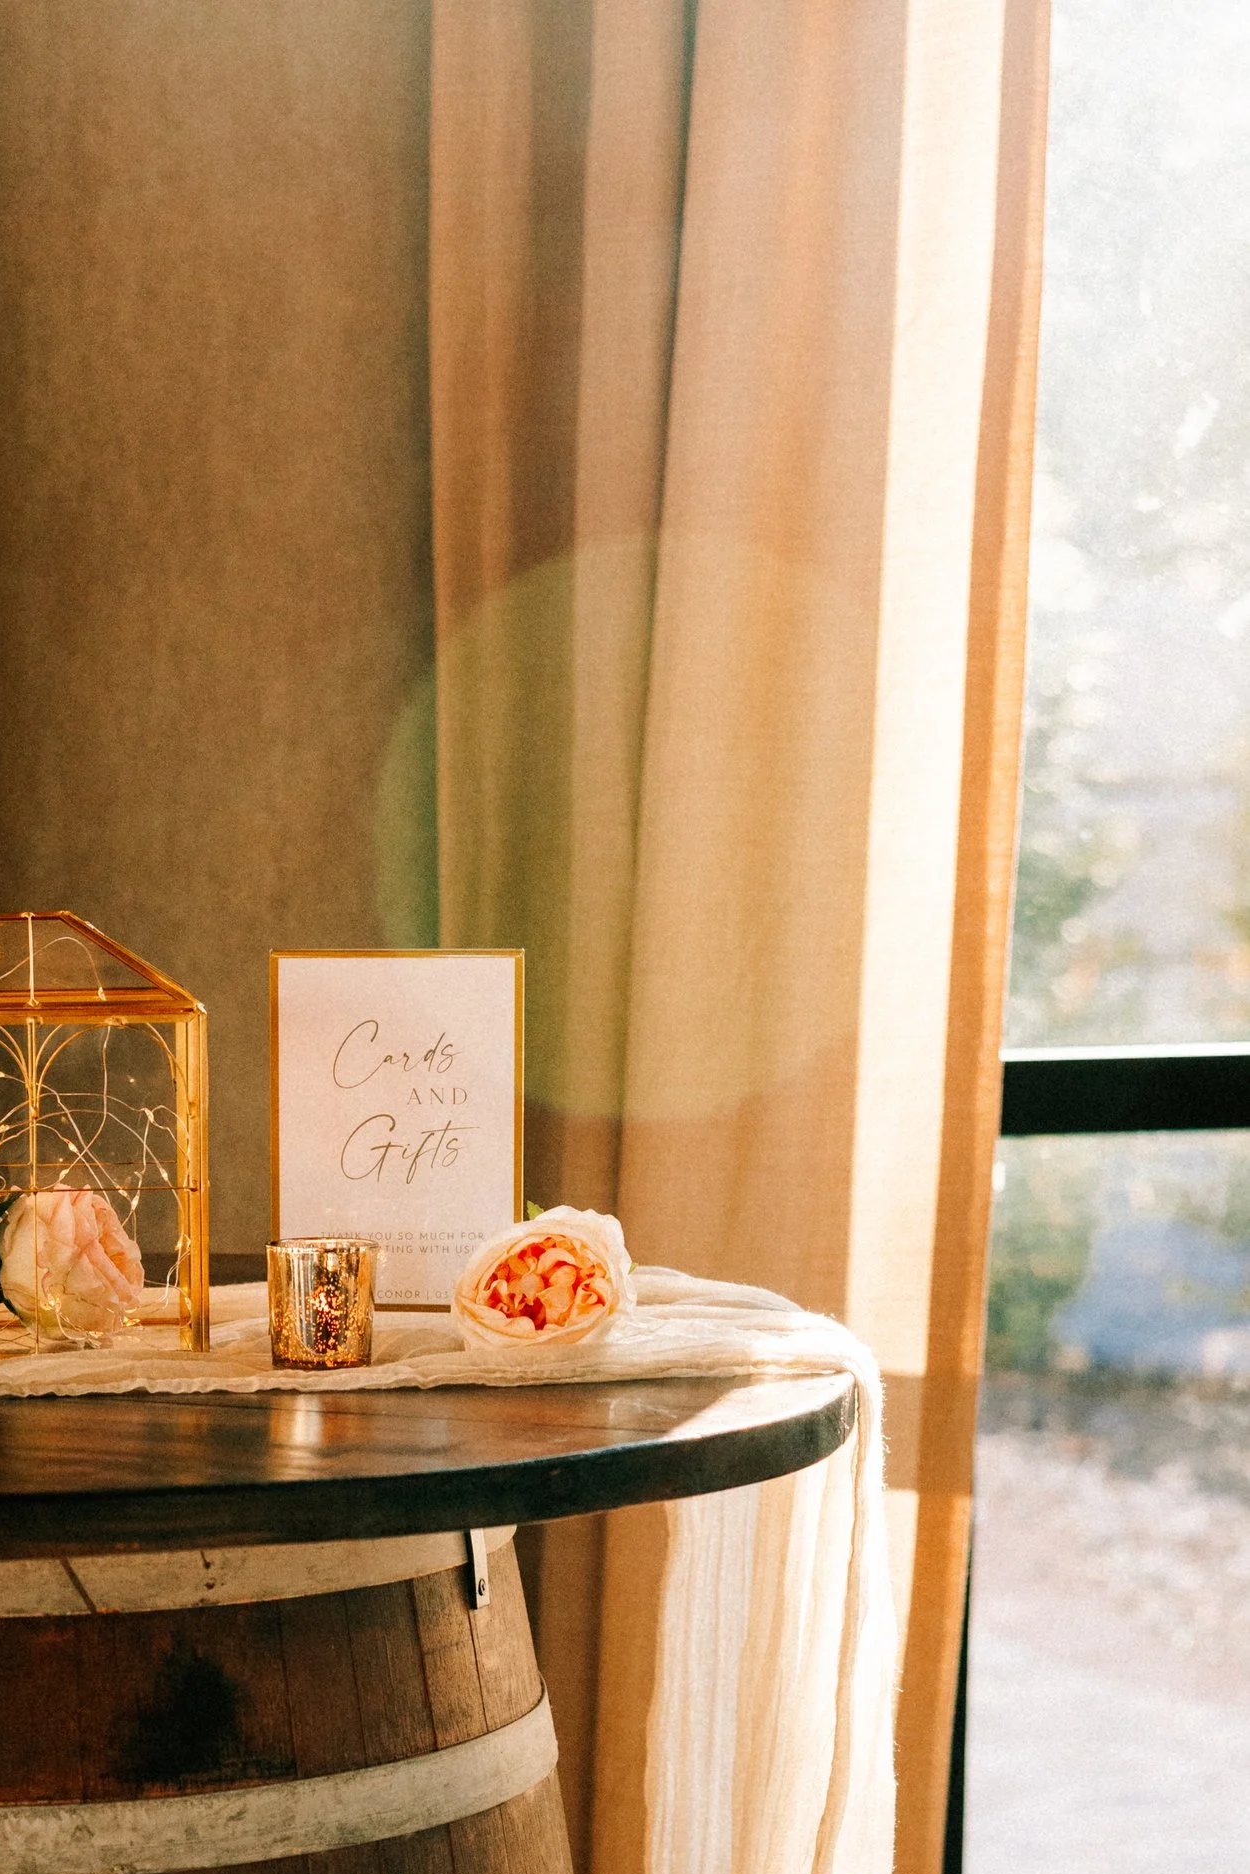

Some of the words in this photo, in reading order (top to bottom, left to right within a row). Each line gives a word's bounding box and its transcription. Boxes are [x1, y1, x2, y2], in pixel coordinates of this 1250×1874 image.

[332, 1019, 464, 1089] Cards
[406, 1086, 469, 1106] AND
[340, 1113, 481, 1185] Gifts
[320, 1231, 362, 1240] THANK
[367, 1231, 393, 1241] YOU
[397, 1231, 415, 1241] SO
[419, 1231, 456, 1241] MUCH
[460, 1231, 485, 1241] FOR
[418, 1244, 451, 1254] WITH
[376, 1289, 421, 1299] CONOR
